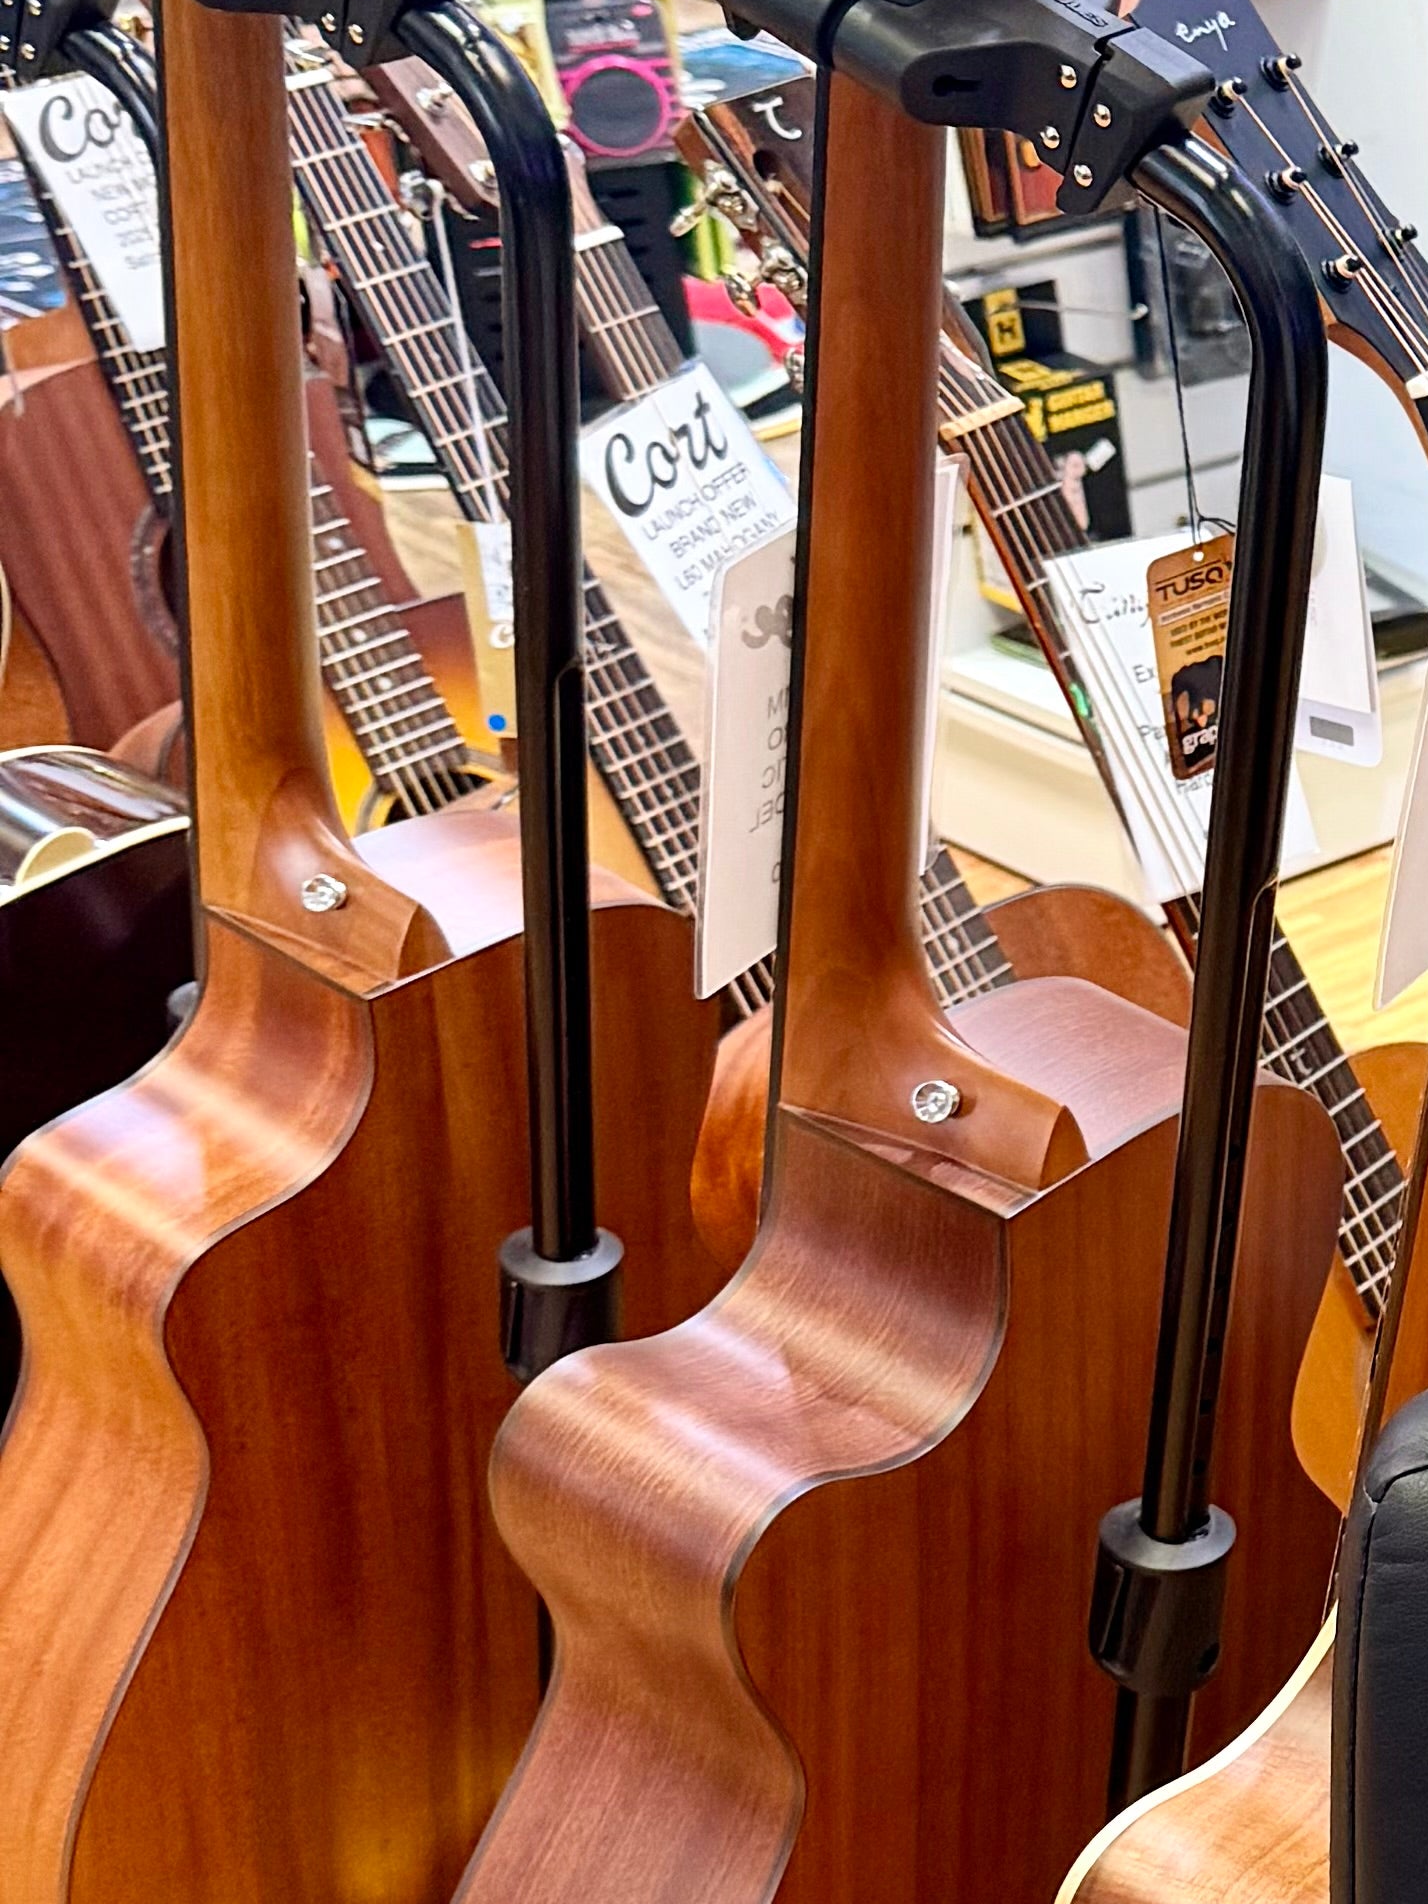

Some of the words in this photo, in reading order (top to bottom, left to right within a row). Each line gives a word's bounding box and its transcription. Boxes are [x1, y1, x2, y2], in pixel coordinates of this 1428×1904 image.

[604, 391, 729, 518] Cort
[642, 492, 703, 541] LAUNCH
[699, 461, 751, 502] OFFER
[669, 515, 722, 559] BRAND
[719, 494, 758, 526] NEW
